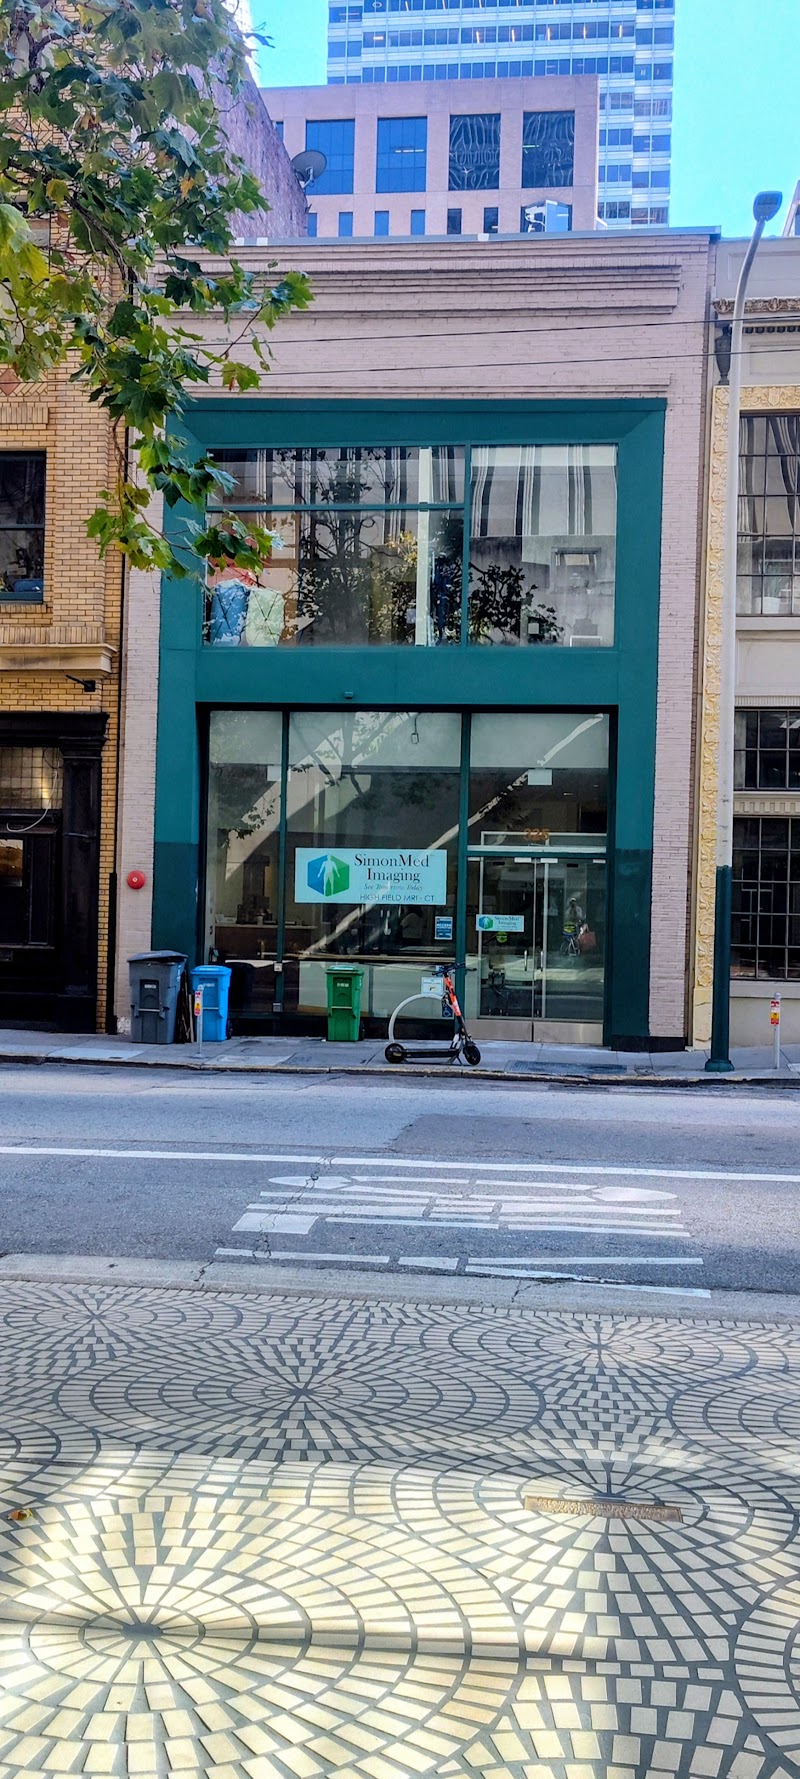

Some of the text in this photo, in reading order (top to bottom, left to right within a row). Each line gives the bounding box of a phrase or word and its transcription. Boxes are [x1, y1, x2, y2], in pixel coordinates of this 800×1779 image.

[523, 827, 549, 841] 325
[367, 868, 421, 884] Imaging
[424, 894, 435, 902] CT
